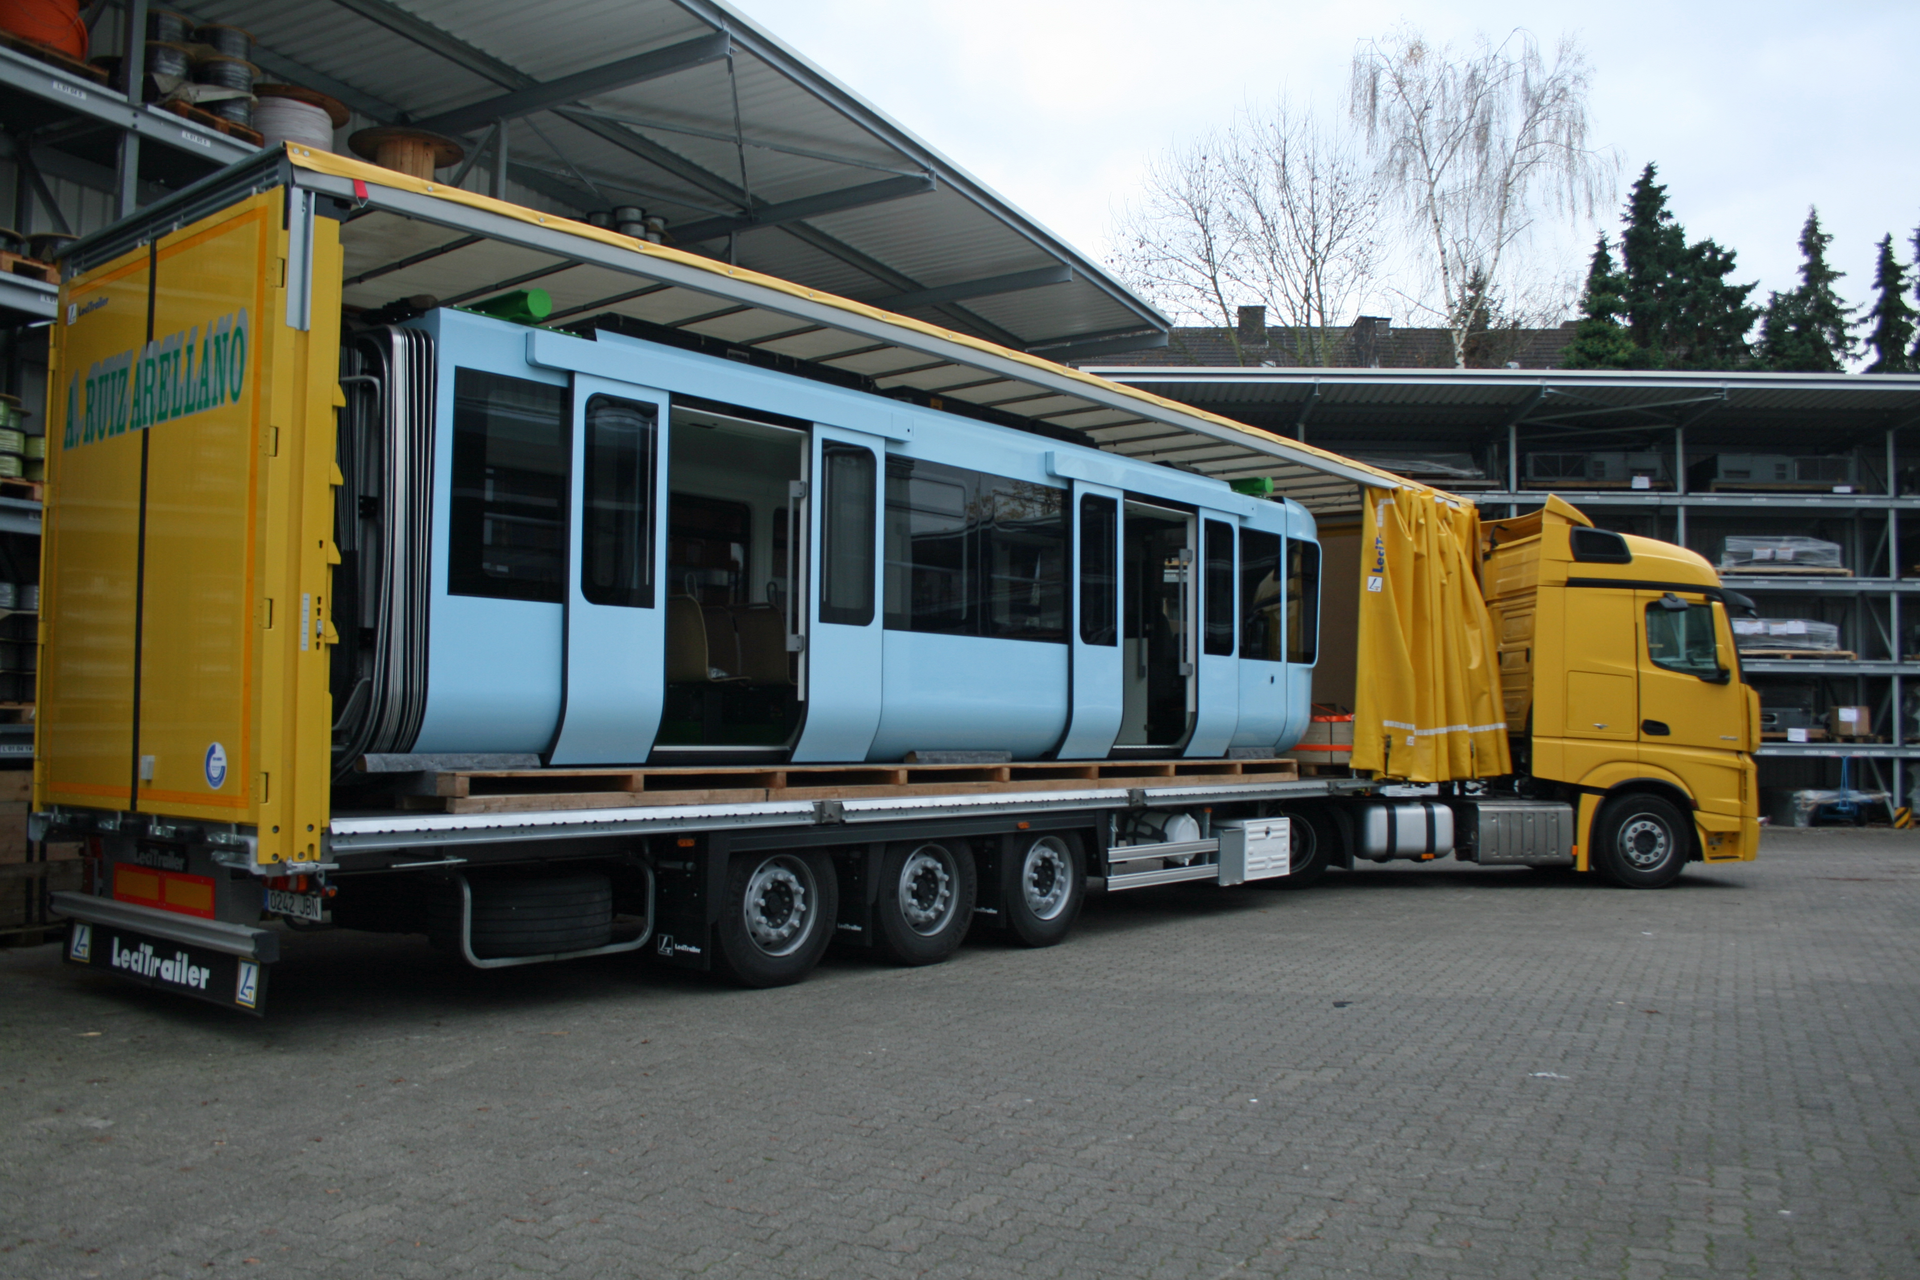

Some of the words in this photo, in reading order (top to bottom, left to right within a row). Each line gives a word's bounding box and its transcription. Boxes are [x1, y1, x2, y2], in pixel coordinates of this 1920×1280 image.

[83, 360, 131, 443] RUIZ
[130, 318, 247, 430] ARELLANO
[133, 847, 186, 872] LeciTrailer
[270, 891, 295, 914] 0242
[299, 895, 319, 918] JBN
[111, 936, 211, 990] LeciTrailer
